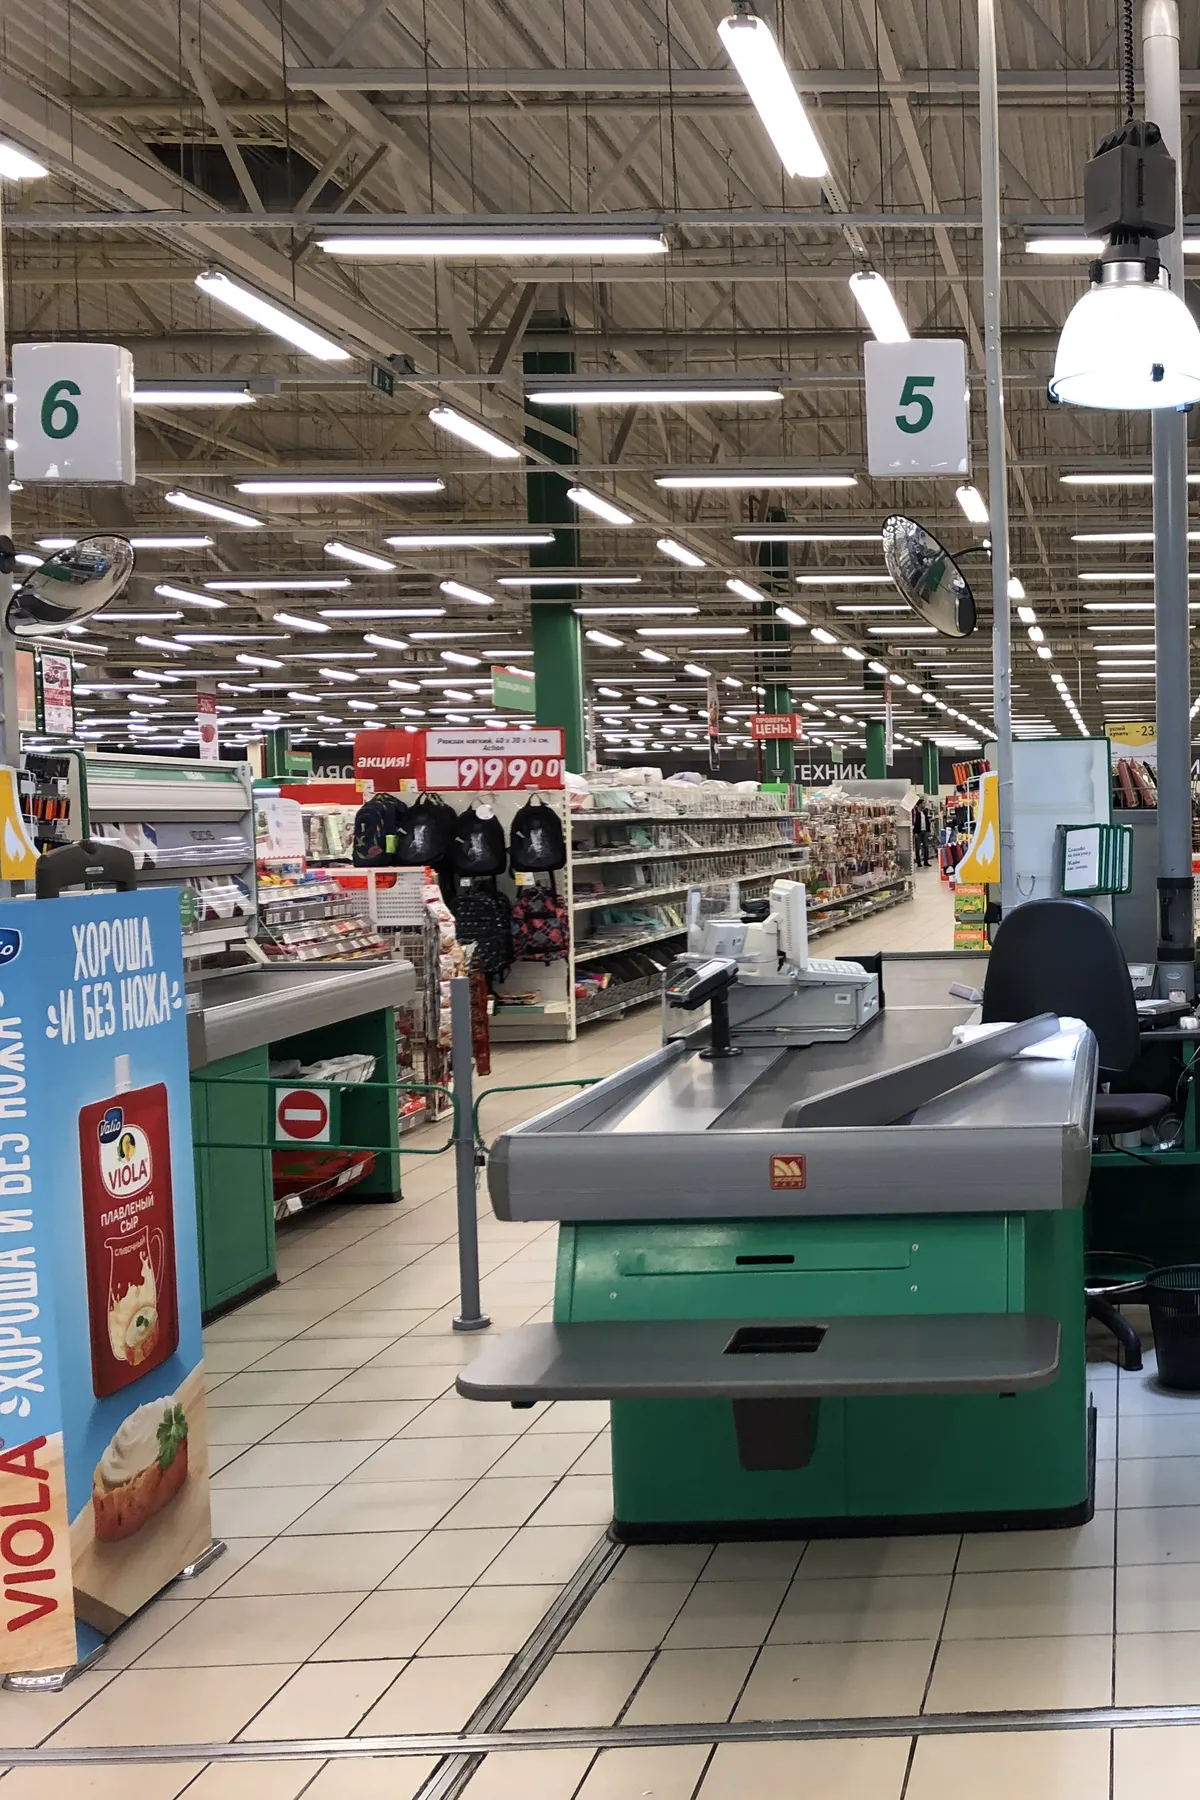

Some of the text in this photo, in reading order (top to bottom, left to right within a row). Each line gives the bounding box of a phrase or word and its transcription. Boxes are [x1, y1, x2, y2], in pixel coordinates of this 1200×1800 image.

[41, 380, 81, 439] 6
[895, 376, 935, 434] 5
[756, 724, 792, 735] ЦЕНЫ
[1136, 726, 1156, 736] -23
[307, 765, 354, 778] МЯС
[357, 754, 411, 769] акция!
[793, 764, 867, 780] ТЕХНИК
[72, 916, 154, 981] ХОРОША
[59, 971, 171, 1045] И БЕЗ НОЖА
[100, 1118, 121, 1136] Valio
[108, 1166, 148, 1190] VIOLA
[101, 1191, 154, 1227] ПЛАВЛЕНЫЙ
[120, 1215, 139, 1233] СЫР
[0, 1435, 58, 1632] VIOLA
